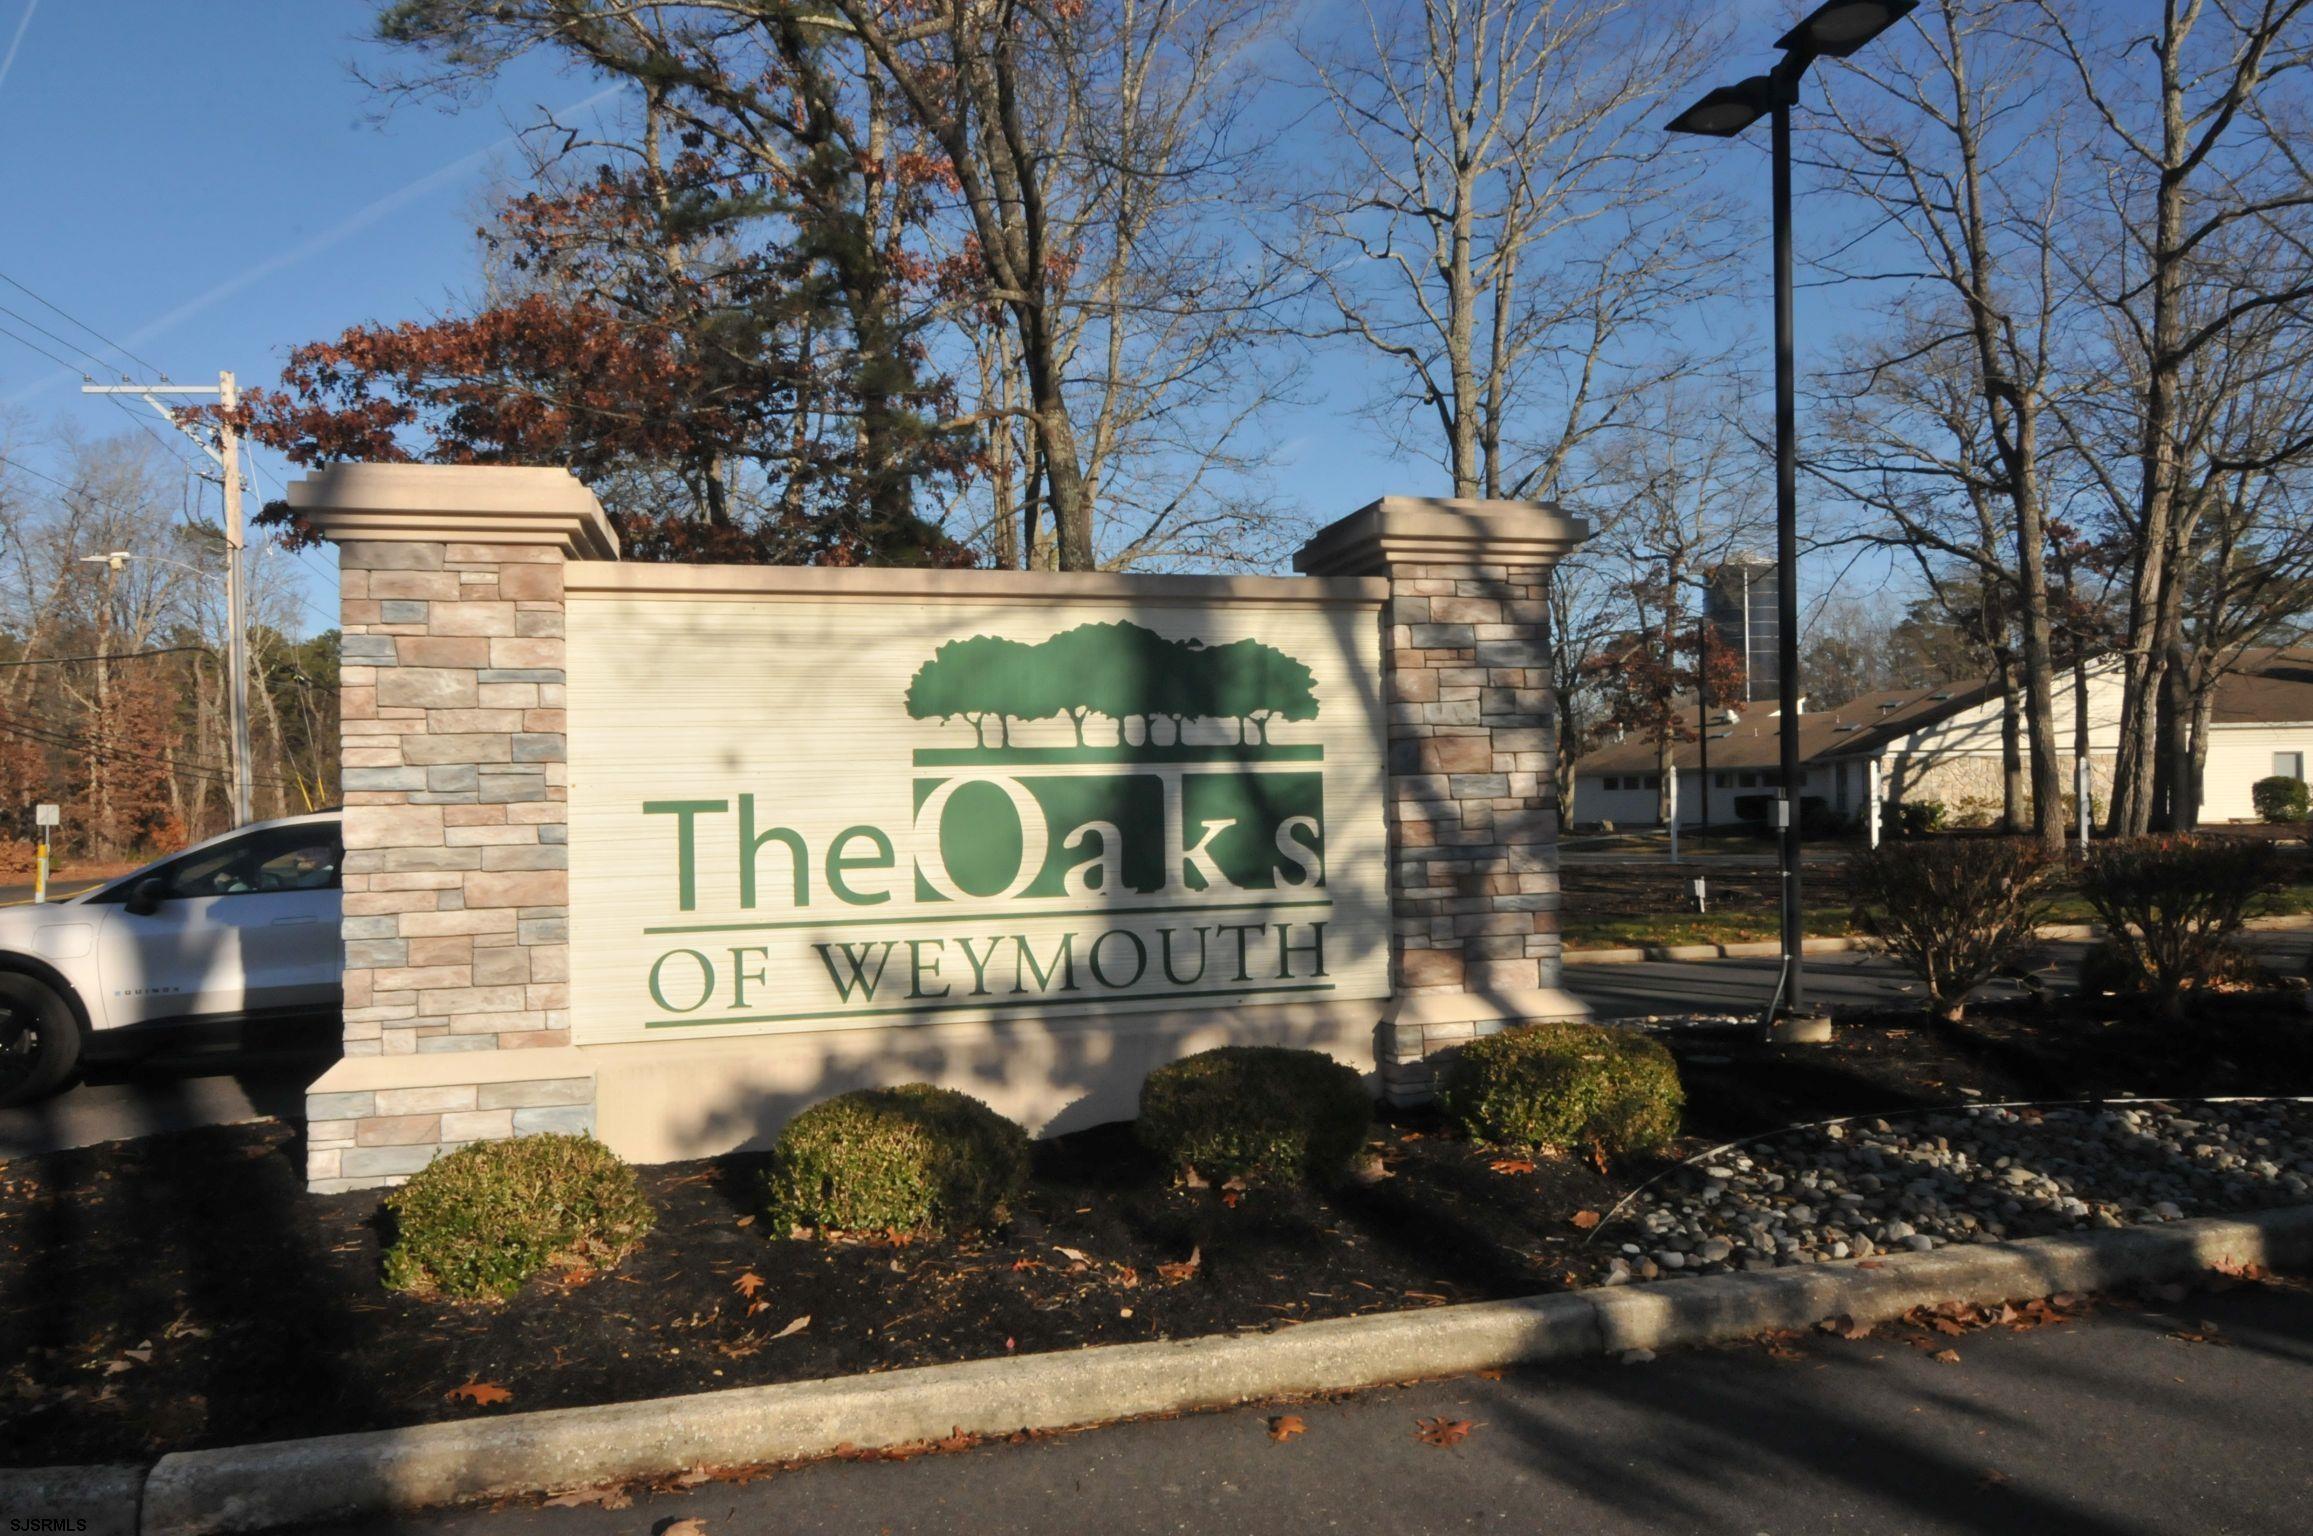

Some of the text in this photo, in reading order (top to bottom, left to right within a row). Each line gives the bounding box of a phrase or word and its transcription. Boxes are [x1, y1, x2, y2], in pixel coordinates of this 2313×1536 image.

[643, 773, 1324, 911] The Oaks
[648, 921, 1331, 1013] OF WEYMOUTH
